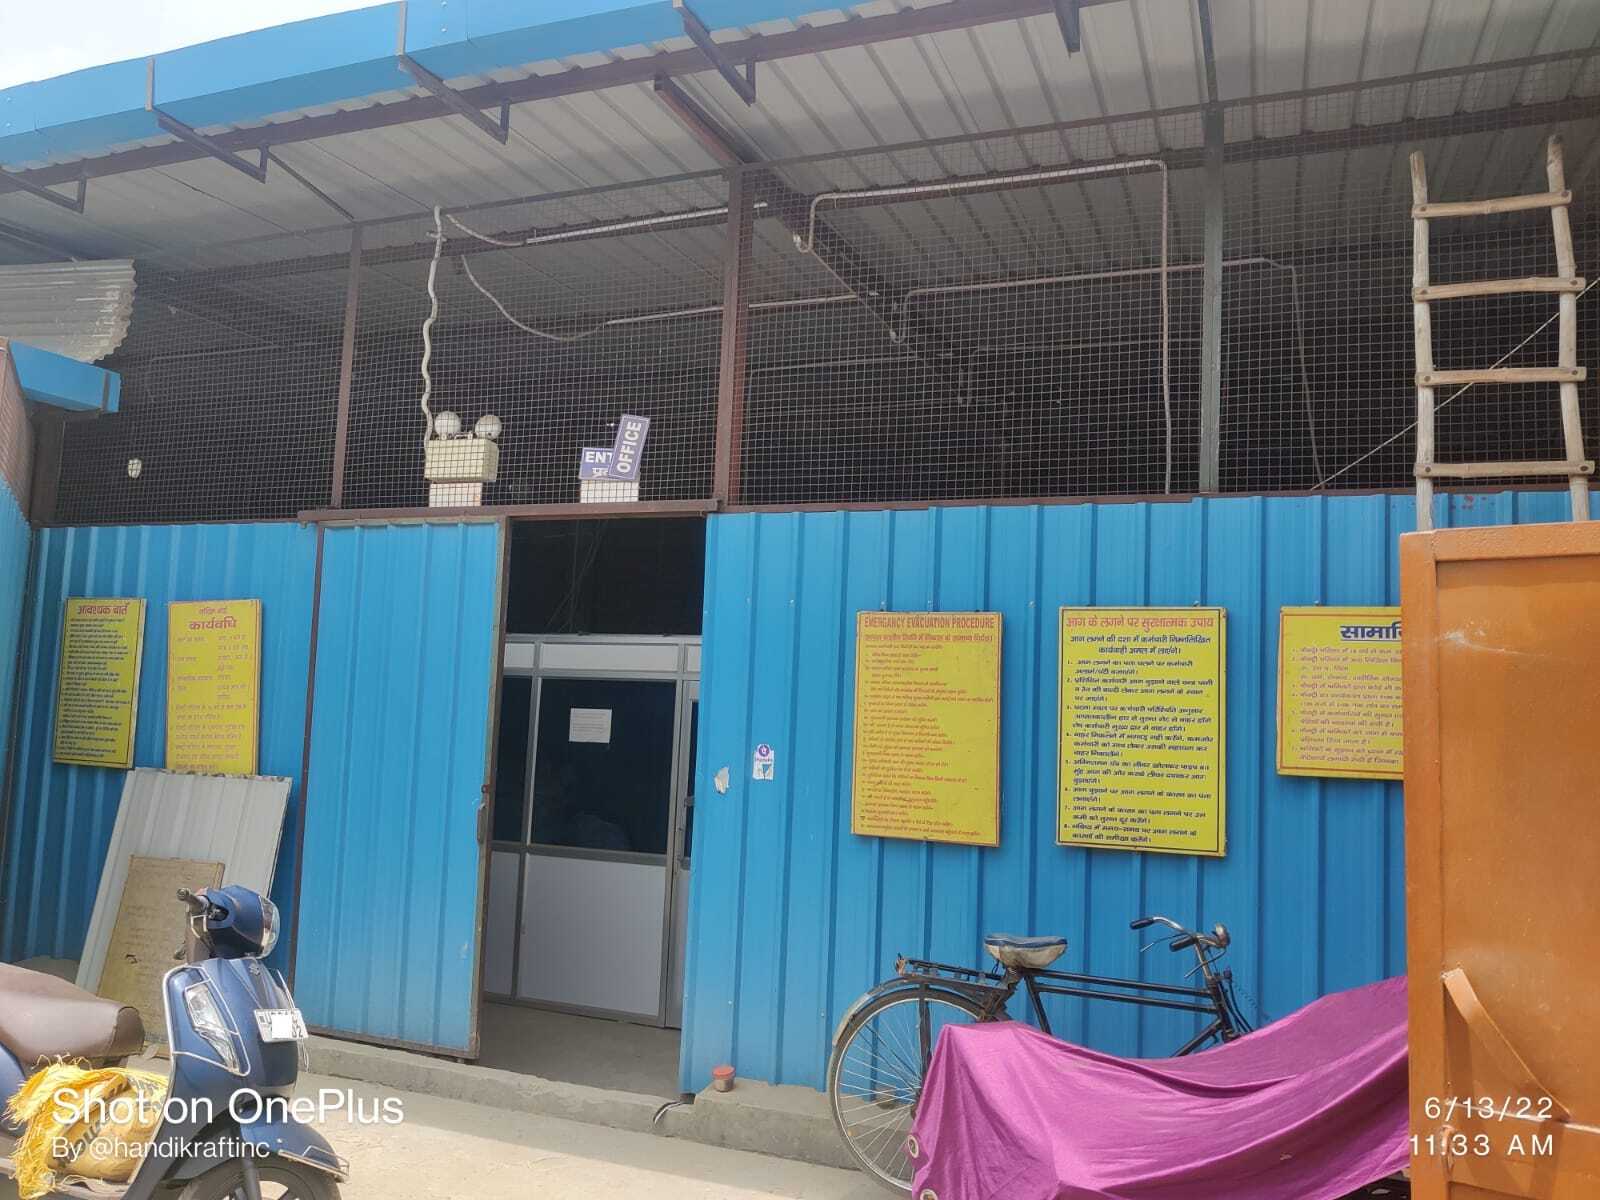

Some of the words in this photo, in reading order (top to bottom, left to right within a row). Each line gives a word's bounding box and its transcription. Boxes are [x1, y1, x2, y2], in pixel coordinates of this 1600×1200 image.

[616, 421, 642, 473] OFFICE
[908, 616, 949, 628] EVACUATION
[952, 616, 994, 629] PROCEDURE
[1067, 616, 1085, 626] आग
[1088, 615, 1097, 626] के
[1101, 615, 1123, 626] लगने
[1127, 616, 1139, 627] पर
[1190, 617, 1213, 627] उपाय
